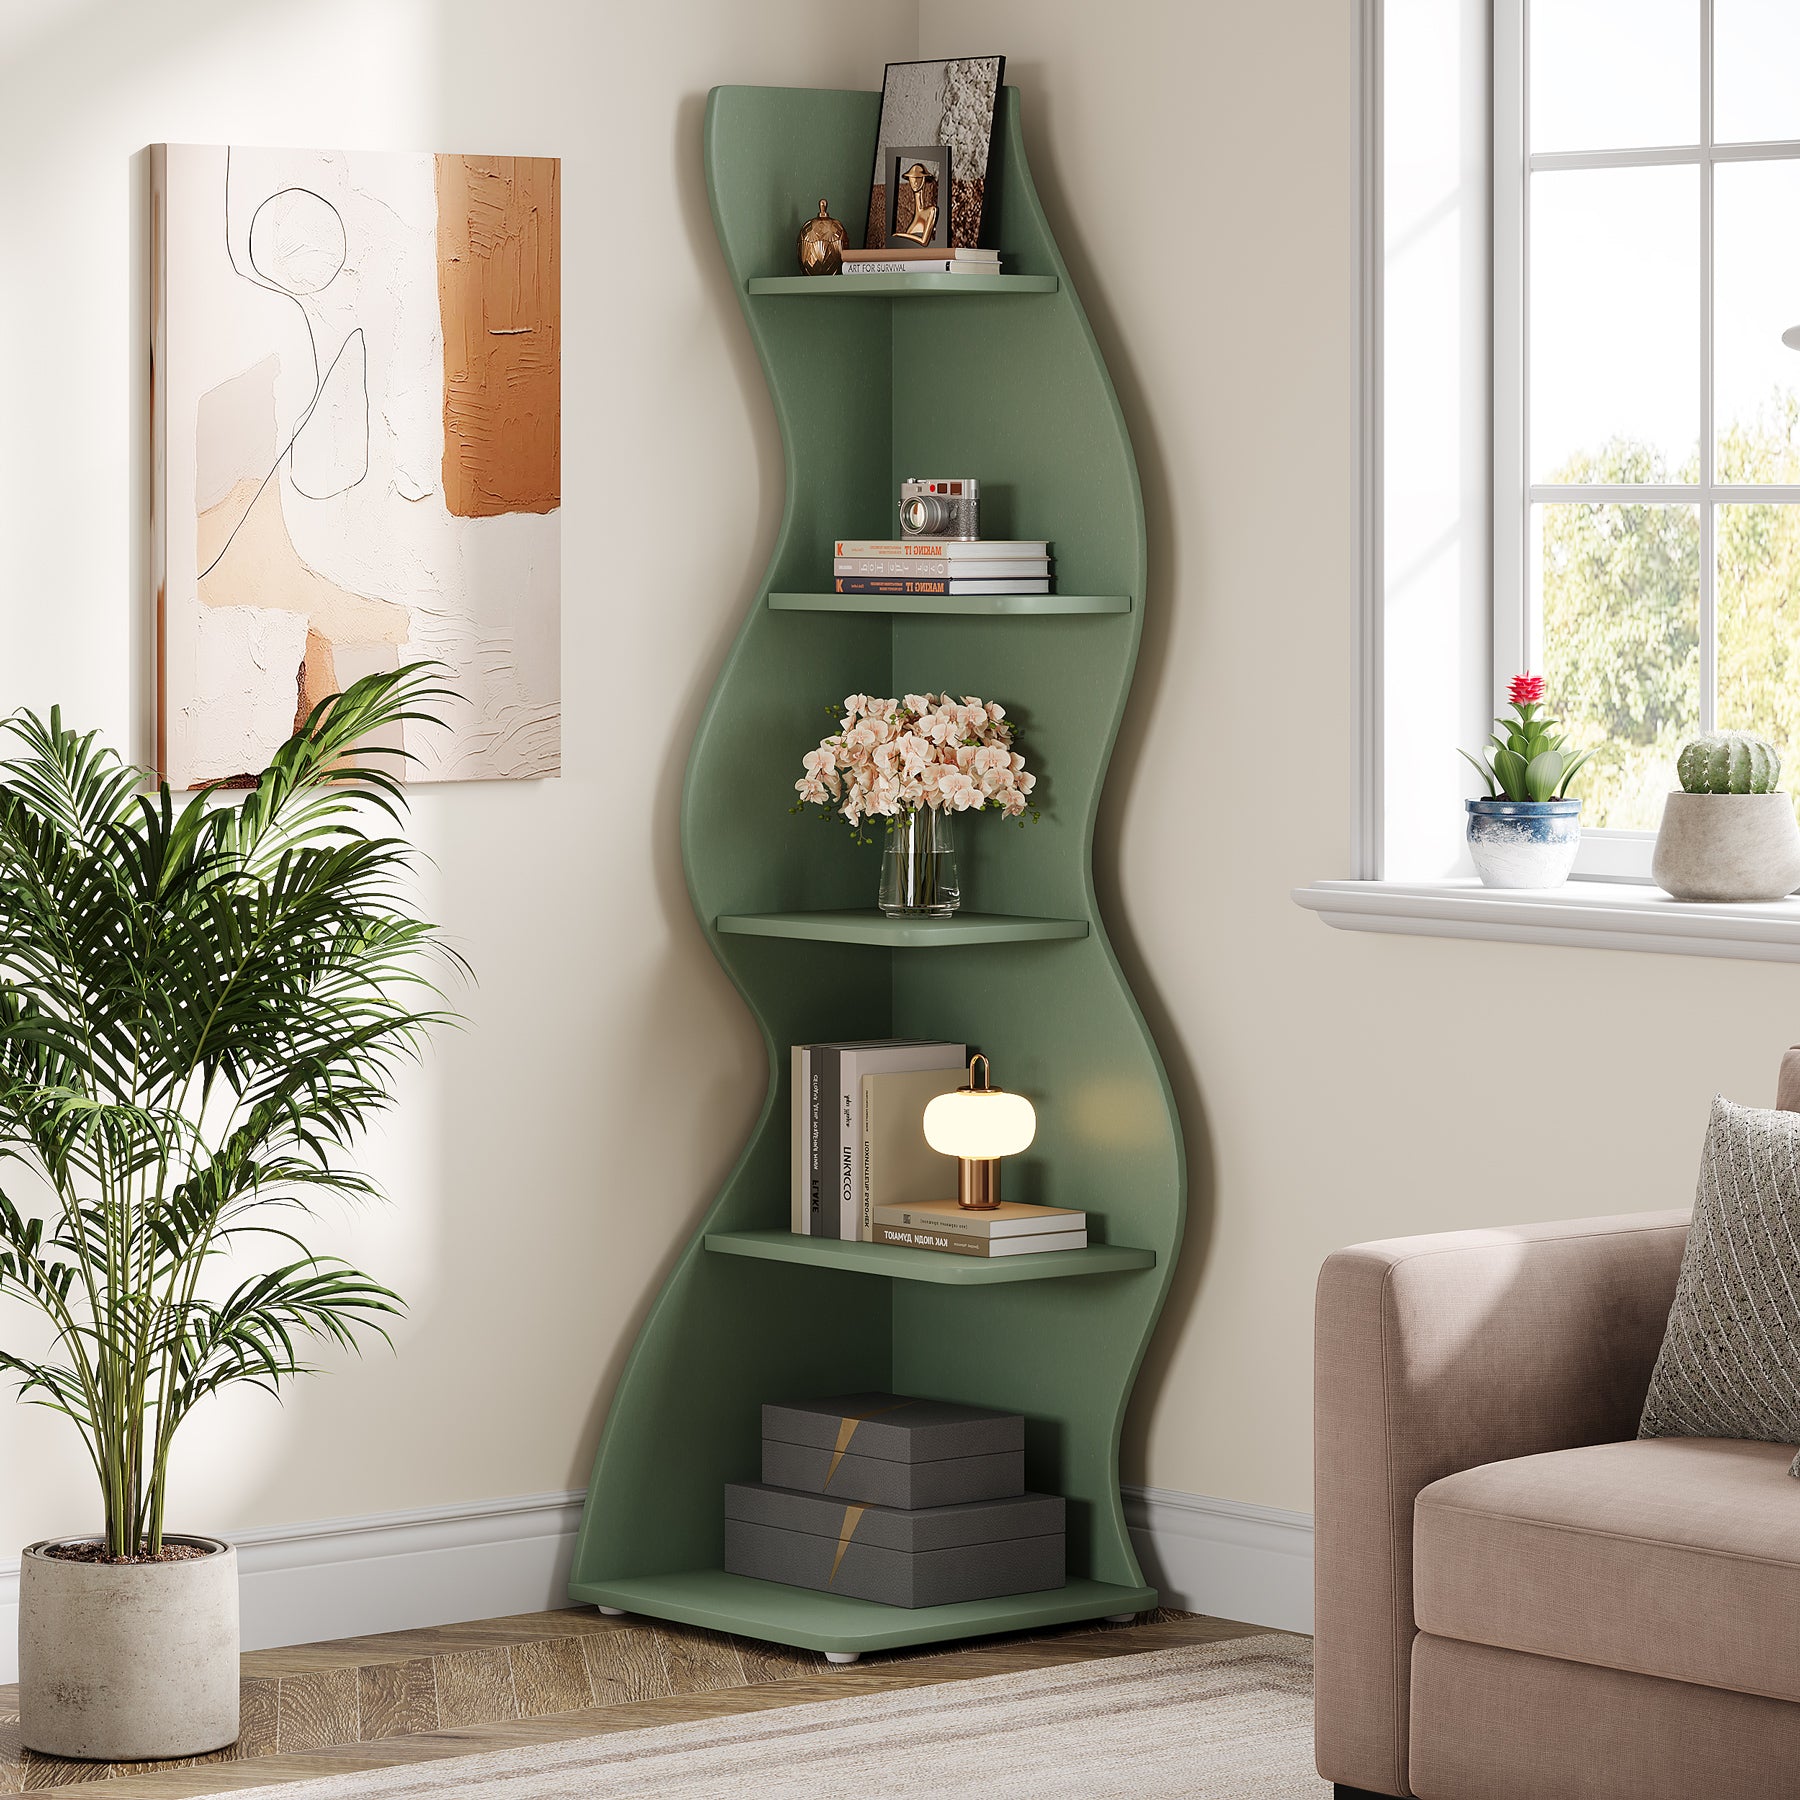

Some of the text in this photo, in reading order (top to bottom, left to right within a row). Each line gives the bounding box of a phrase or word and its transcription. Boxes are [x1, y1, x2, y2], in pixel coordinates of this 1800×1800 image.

[848, 263, 906, 272] ART FOR SURVIVAL
